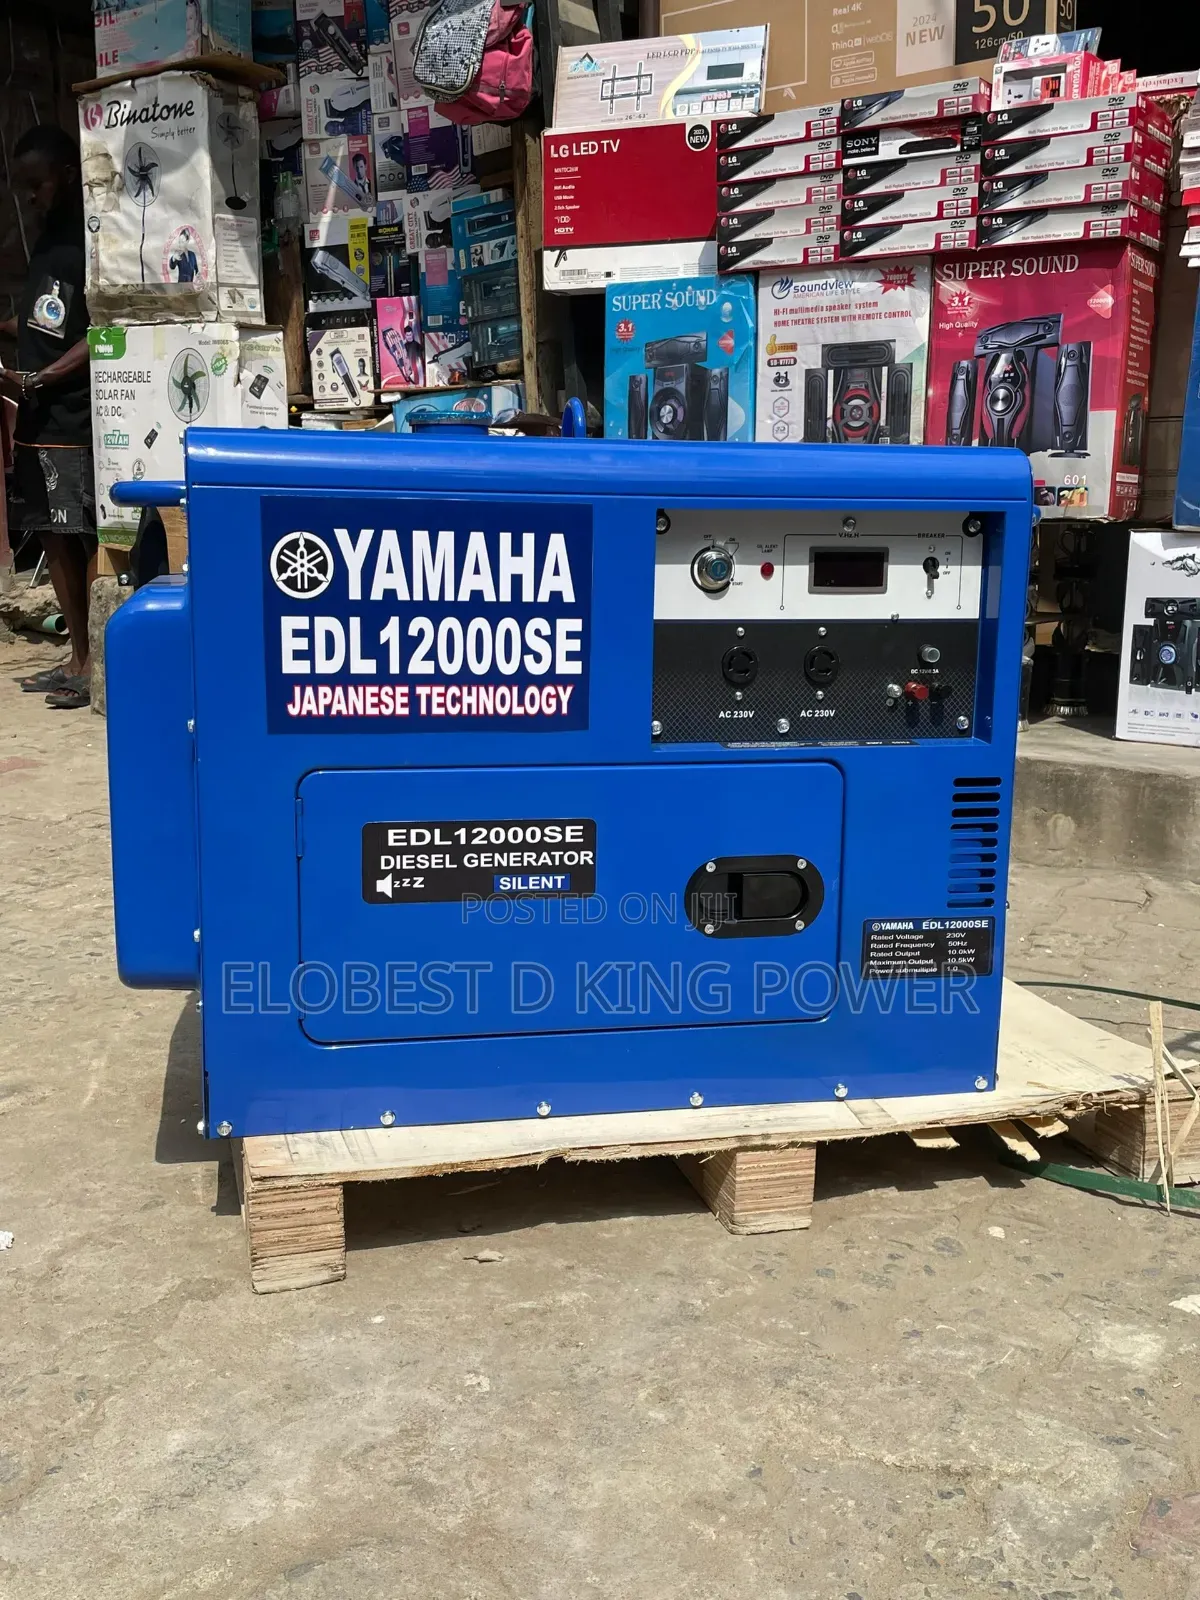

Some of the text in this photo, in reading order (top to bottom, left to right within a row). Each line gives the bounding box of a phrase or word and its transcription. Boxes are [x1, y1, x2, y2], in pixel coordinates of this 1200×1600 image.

[832, 2, 862, 16] Real 4K
[1059, 0, 1073, 20] 50
[912, 13, 937, 27] 2024
[971, 0, 1029, 33] 50
[906, 25, 946, 47] NEW
[831, 39, 854, 51] ThinQ
[1072, 55, 1082, 100] VOLTGUARD
[1142, 77, 1184, 88] Exclusively
[853, 99, 862, 107] LG
[104, 95, 195, 129] Binatone
[997, 113, 1008, 121] LG
[151, 126, 196, 141] Simply better
[728, 123, 737, 131] LG
[689, 135, 708, 144] NEW
[846, 137, 878, 148] SONY
[550, 138, 620, 158] LG LED TV
[730, 187, 739, 195] LG
[993, 181, 1003, 189] LG
[992, 217, 1003, 225] LG
[942, 254, 1079, 281] SUPER SOUND
[793, 279, 854, 294] soundview
[841, 287, 860, 295] STYLE
[612, 289, 718, 312] SUPER SOUND
[951, 296, 969, 307] 3.1
[774, 301, 879, 316] HI-FI multimedia speaker system
[774, 320, 789, 328] HOME
[790, 316, 815, 326] THEATRE
[816, 316, 840, 324] SYSTEM
[857, 313, 882, 321] REMOTE
[883, 310, 912, 320] CONTROL
[618, 323, 633, 332] 3.1
[939, 320, 978, 332] High Quality
[95, 370, 151, 383] RECHARGEABLE
[95, 389, 136, 400] SOLAR FAN
[96, 405, 122, 417] AC & DC
[104, 430, 129, 446] 12V7AH
[1064, 474, 1087, 485] 601
[333, 528, 576, 603] YAMAHA
[280, 615, 583, 675] EDL12000SE
[287, 684, 575, 717] JAPANESE TECHNOLOGY
[733, 710, 754, 718] 230V
[800, 709, 835, 718] AC 230V
[387, 825, 584, 847] EDL12000SE
[380, 850, 593, 870] DIESEL GENERATOR
[499, 875, 565, 890] SILENT
[880, 920, 989, 931] YAMAHA EDL12000SE
[895, 950, 920, 958] Output
